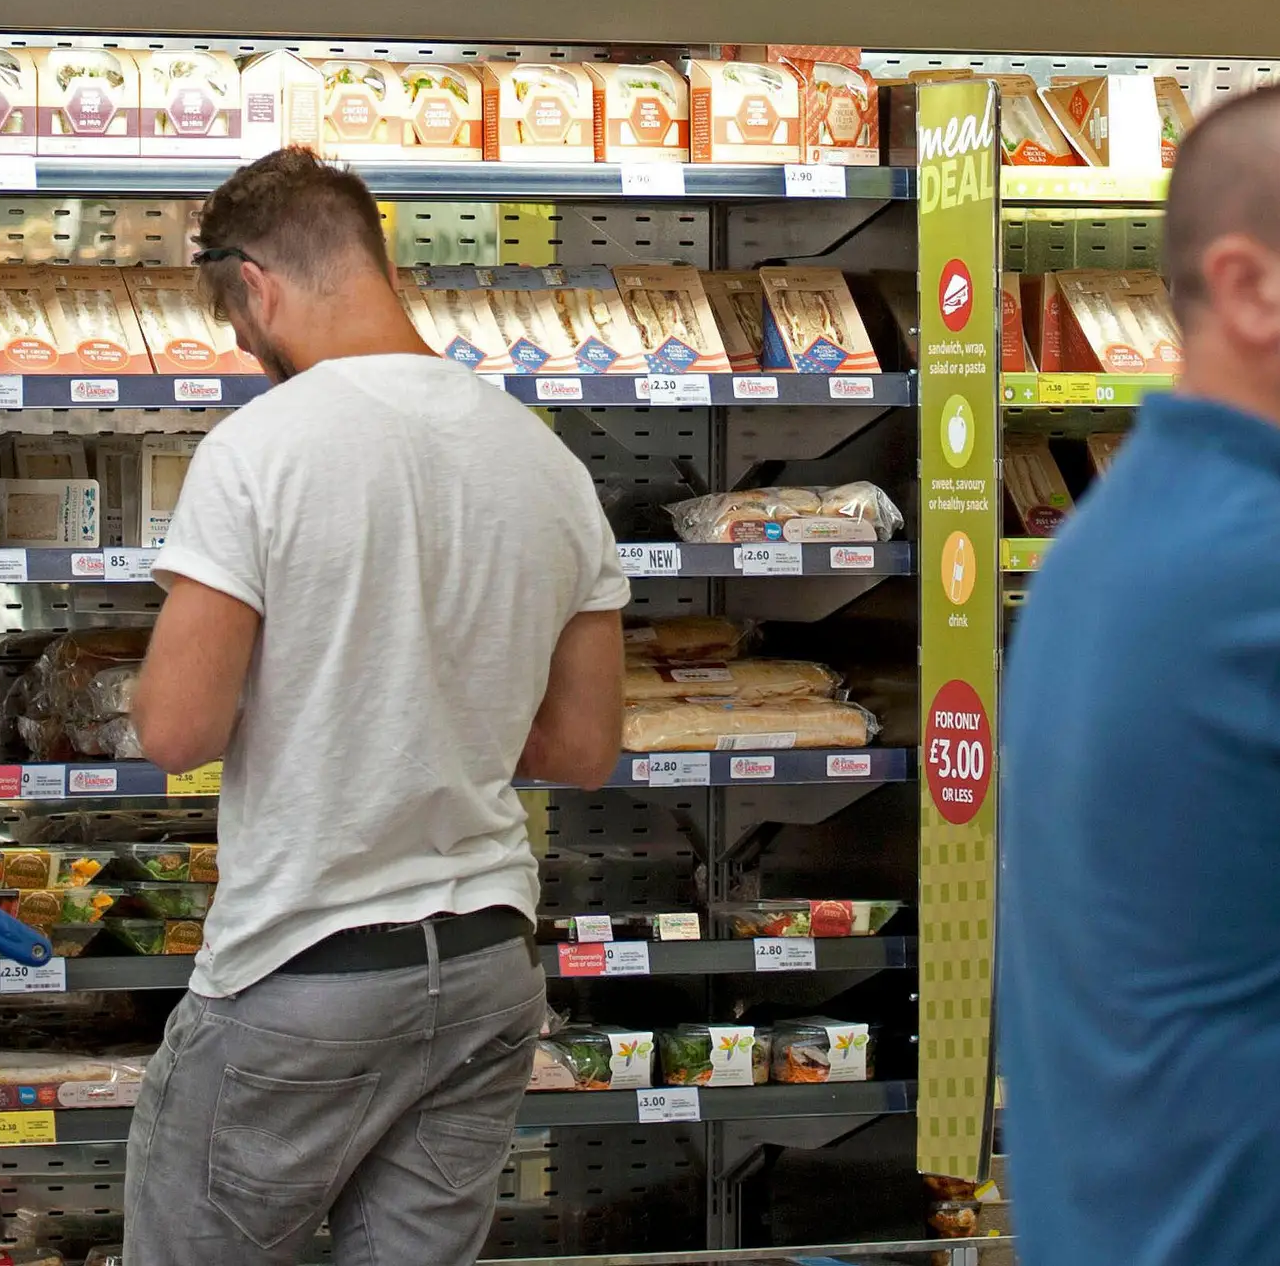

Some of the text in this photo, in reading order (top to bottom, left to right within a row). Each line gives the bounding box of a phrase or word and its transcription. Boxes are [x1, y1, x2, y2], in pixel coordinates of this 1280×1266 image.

[920, 86, 993, 164] meal
[921, 152, 994, 215] DEAL
[928, 340, 987, 358] sandwich, wrap,
[930, 362, 949, 374] salad
[949, 364, 957, 374] or
[965, 363, 986, 376] pasta
[651, 379, 677, 391] £2.30
[931, 479, 986, 494] sweet, savoury
[928, 497, 989, 512] or healthy snack
[649, 549, 673, 569] NEW
[744, 550, 770, 561] £2.60
[948, 613, 969, 627] drink
[935, 711, 981, 730] FOR ONLY
[650, 761, 677, 772] £2.80
[929, 739, 985, 781] £3.00
[942, 787, 973, 803] OR LESS
[756, 945, 782, 956] £2.80
[569, 954, 603, 962] Temporarily
[0, 966, 29, 978] £2.50
[638, 1097, 665, 1108] £3.00
